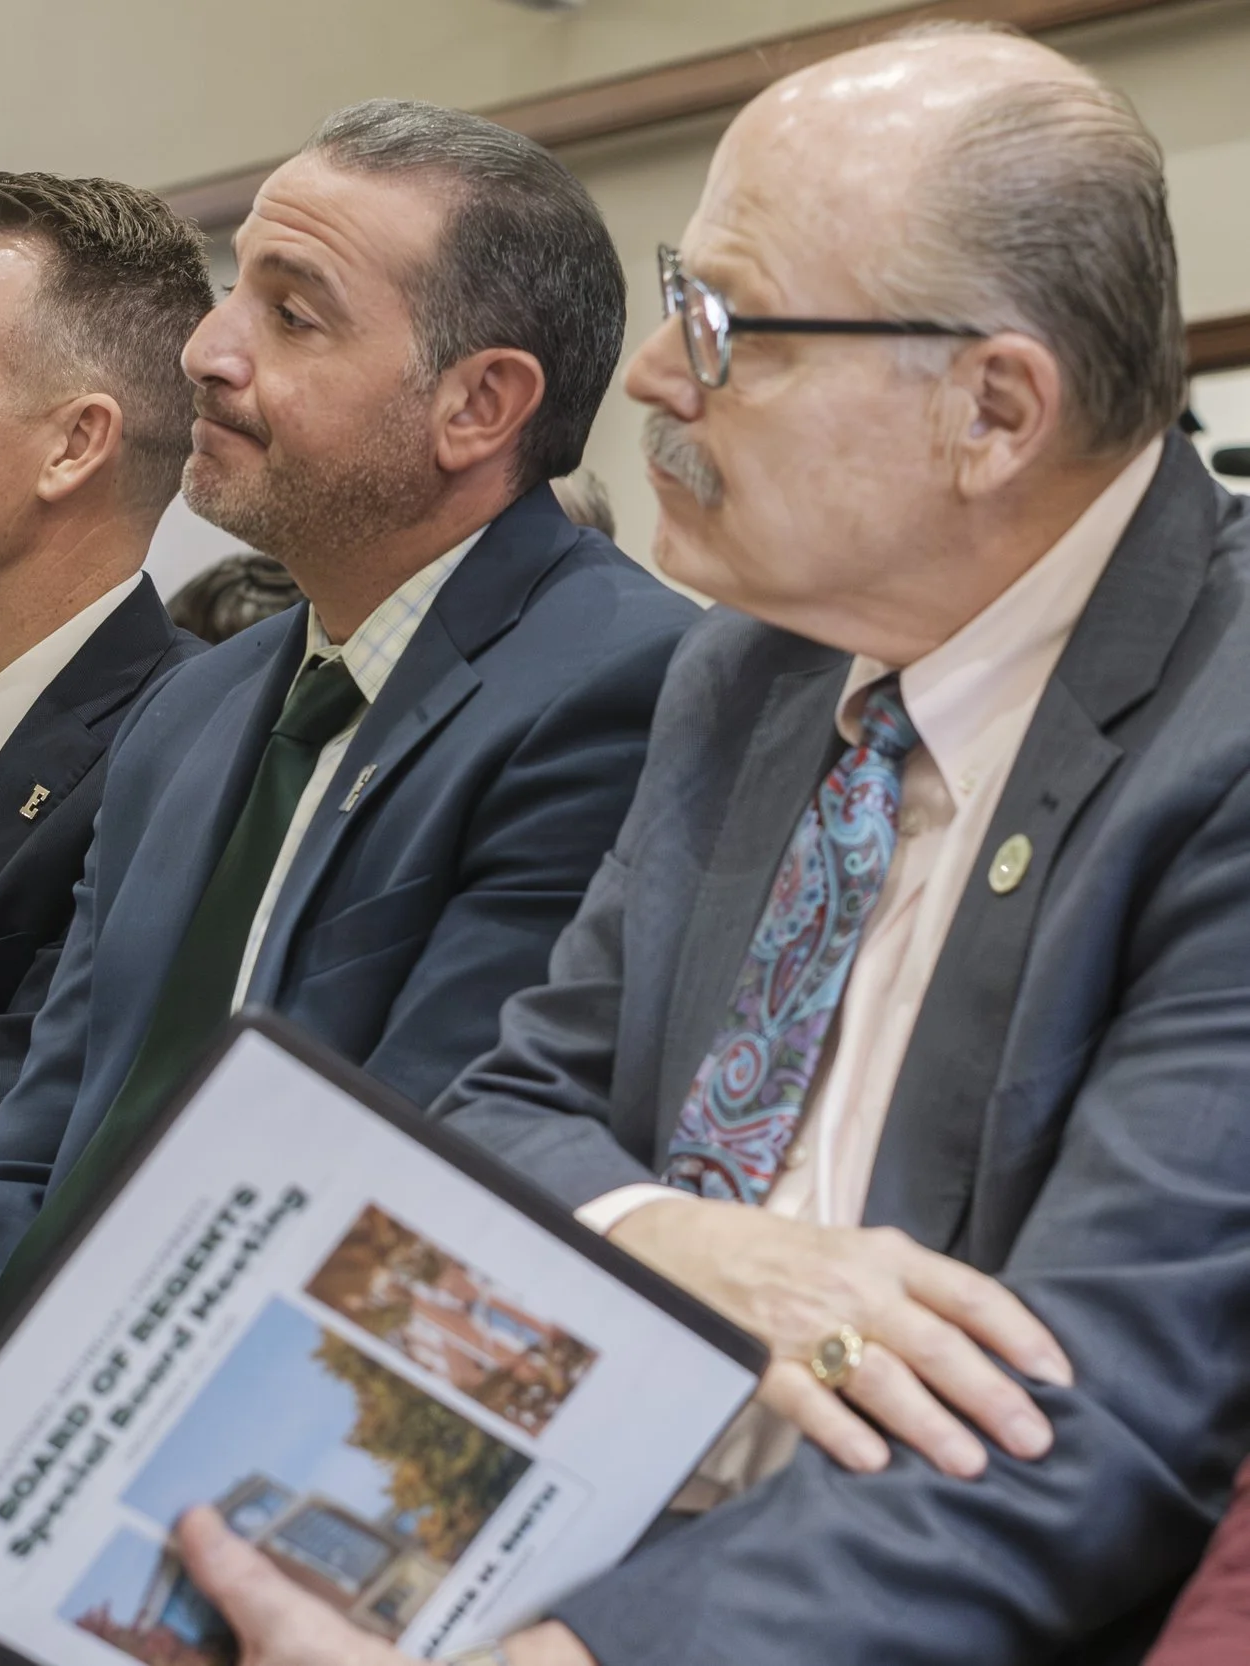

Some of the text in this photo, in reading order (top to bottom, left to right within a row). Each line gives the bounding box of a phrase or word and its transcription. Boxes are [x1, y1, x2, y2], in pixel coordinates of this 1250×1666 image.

[19, 784, 51, 820] E
[6, 1432, 113, 1560] Special
[106, 1324, 195, 1431] Board
[188, 1184, 311, 1323] Meeting
[90, 1348, 130, 1398] OF
[128, 1186, 258, 1344] REGENTS
